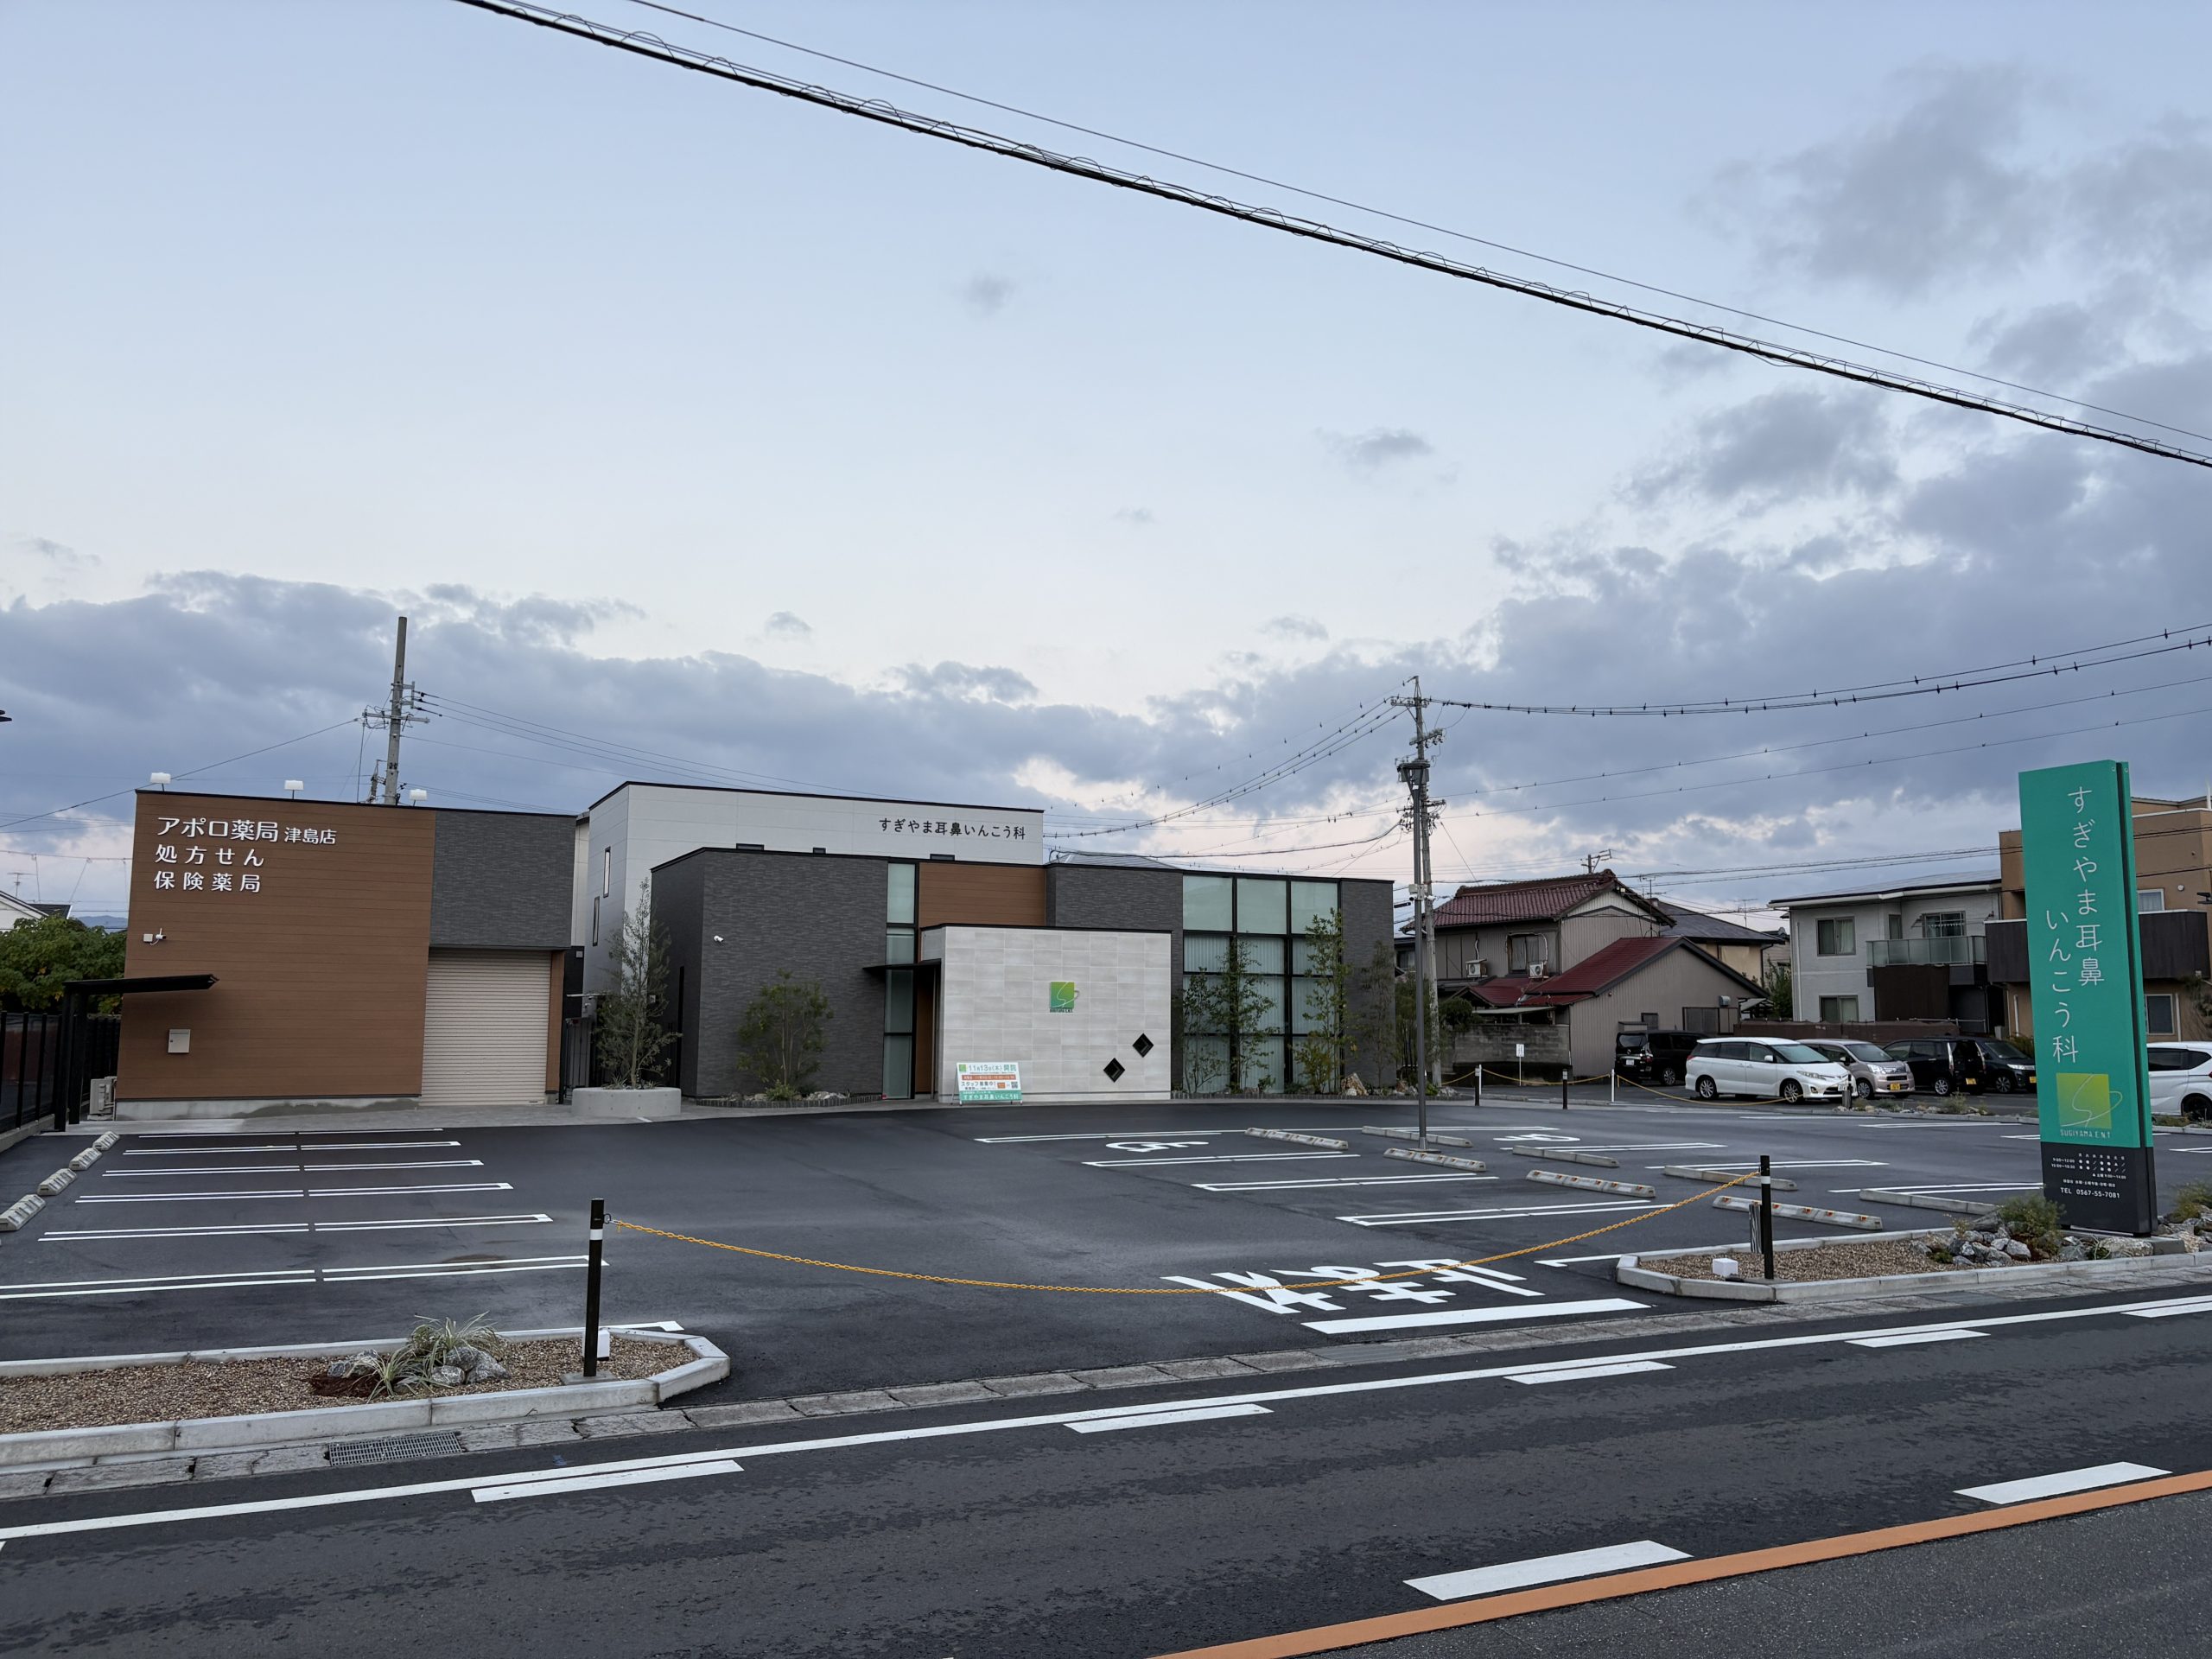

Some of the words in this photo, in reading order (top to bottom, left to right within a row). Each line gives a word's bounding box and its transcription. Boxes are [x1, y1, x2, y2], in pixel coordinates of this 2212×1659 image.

[157, 817, 279, 842] アポロ薬局
[284, 827, 337, 845] 津島店
[879, 817, 1026, 841] すぎやま耳鼻いんこう科
[155, 844, 264, 868] 処方せん
[154, 870, 261, 893] 保険薬局
[2068, 786, 2104, 986] すぎやま耳鼻
[2046, 910, 2079, 1064] いんこう科
[2075, 1189, 2120, 1198] 0567-55-7081
